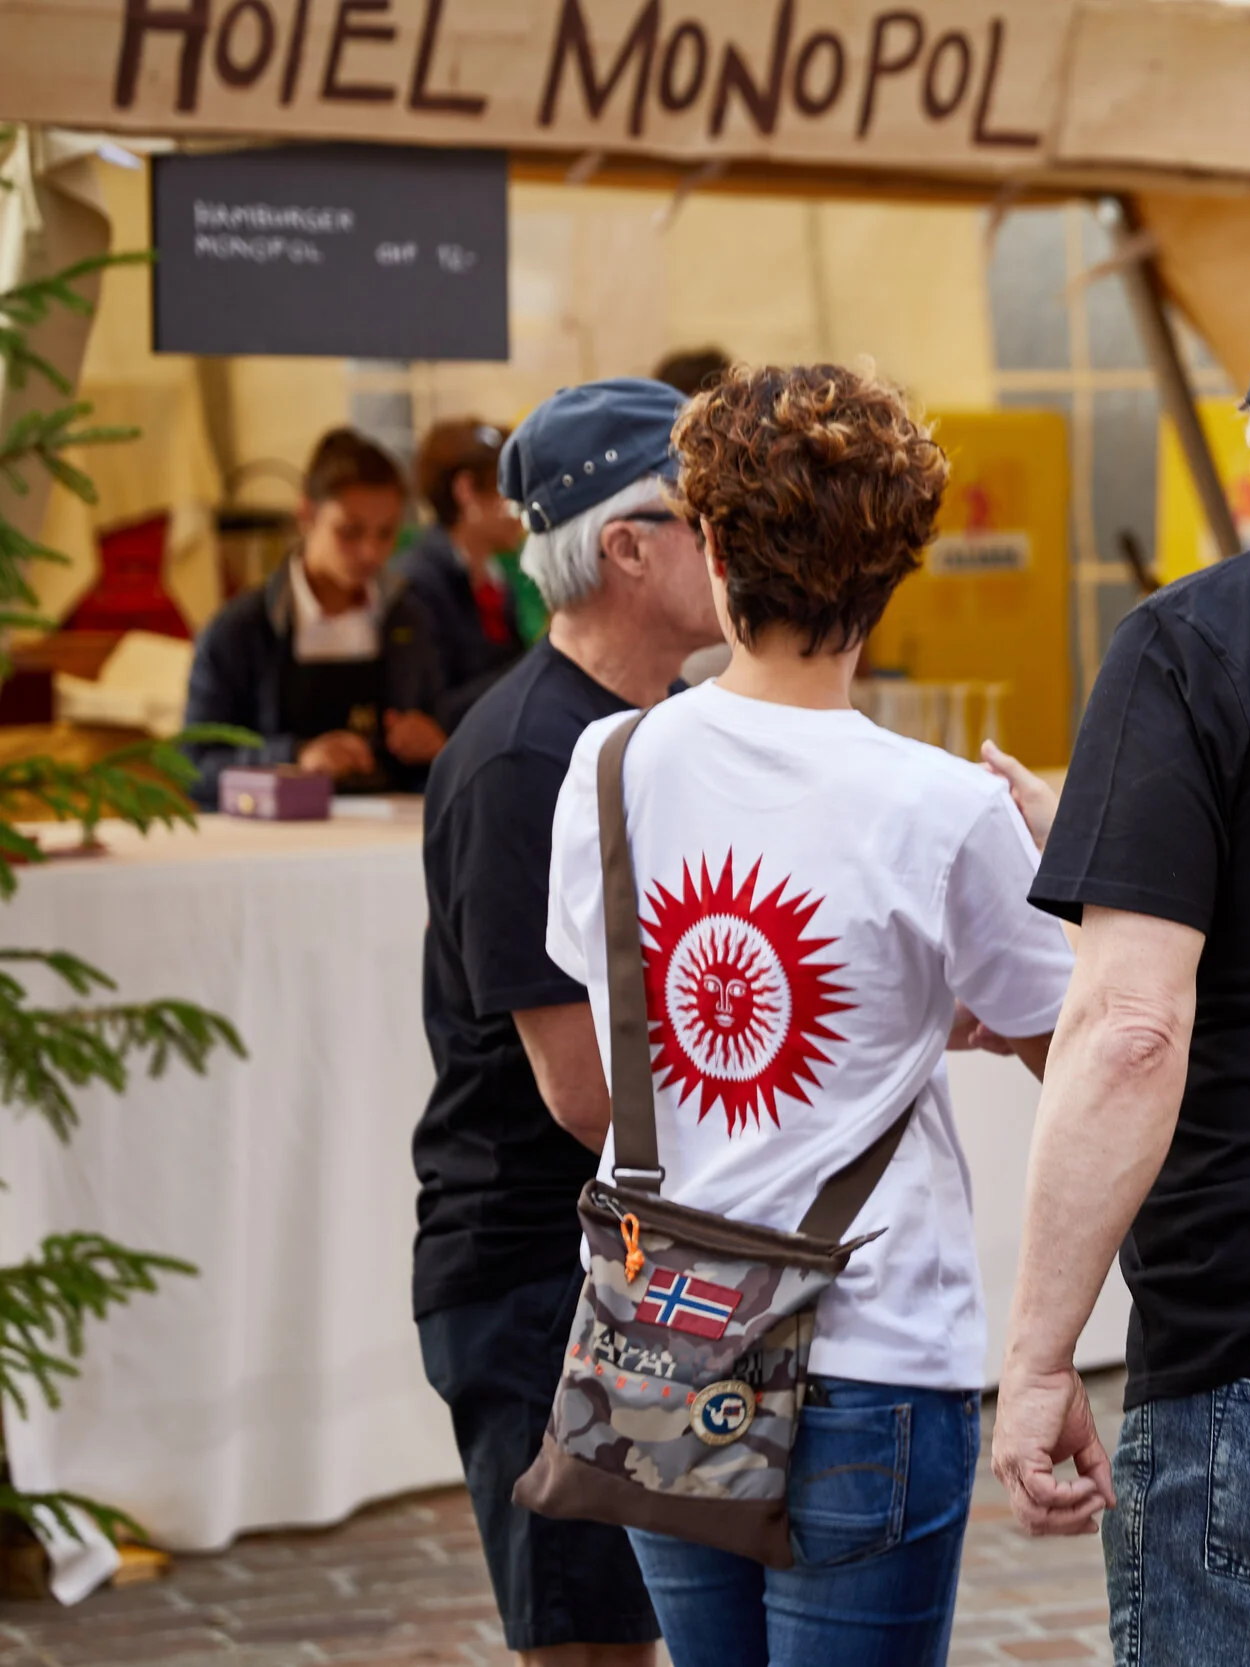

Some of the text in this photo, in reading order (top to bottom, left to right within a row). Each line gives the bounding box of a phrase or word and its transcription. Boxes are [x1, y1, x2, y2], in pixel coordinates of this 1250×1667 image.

[114, 0, 1041, 147] HOTEL MONOPOL
[194, 201, 354, 232] HAMBURGER
[195, 233, 323, 263] MONOPOL
